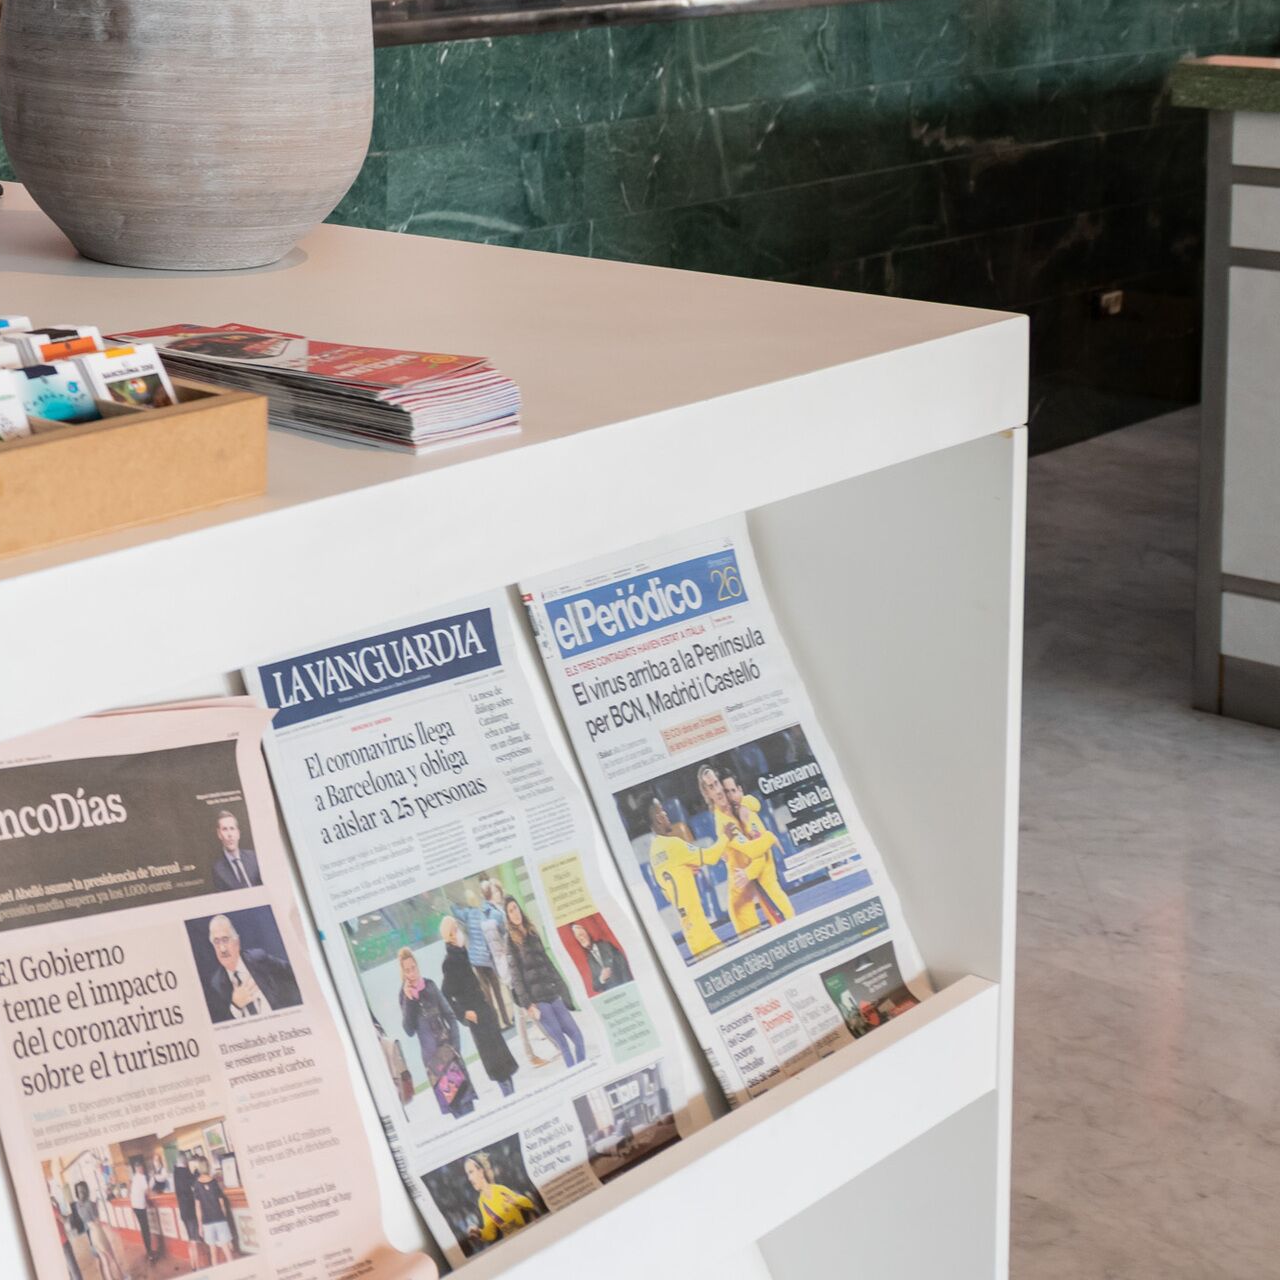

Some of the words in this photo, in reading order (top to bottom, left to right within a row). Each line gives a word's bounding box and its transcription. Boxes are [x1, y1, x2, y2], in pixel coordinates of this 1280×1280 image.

[709, 566, 744, 602] 26
[272, 666, 313, 709] LA
[306, 620, 487, 698] VANGUARDIA
[571, 682, 590, 706] El
[590, 674, 627, 700] virus
[626, 657, 668, 689] arriba
[668, 662, 680, 675] a
[679, 649, 695, 671] la
[693, 626, 765, 667] Península
[585, 713, 611, 743] per
[608, 699, 653, 728] BCN,
[646, 681, 700, 719] Madrid
[704, 657, 761, 696] Castelló
[304, 752, 325, 780] El
[326, 732, 423, 773] coronavirus
[415, 721, 456, 746] llega
[757, 761, 822, 795] Griezmann
[314, 794, 326, 812] a
[325, 770, 409, 809] Barcelona
[406, 764, 418, 788] y
[420, 748, 469, 779] obliga
[787, 791, 820, 814] salva
[818, 785, 832, 802] la
[321, 827, 333, 845] a
[333, 808, 380, 840] aislar
[379, 807, 393, 825] a
[390, 796, 416, 821] 25
[414, 776, 488, 820] personas
[789, 810, 844, 846] papereta
[83, 869, 137, 891] presidencia
[137, 867, 149, 879] de
[19, 943, 125, 983] Gobierno
[697, 979, 714, 999] La
[711, 970, 735, 993] taula
[733, 965, 747, 982] de
[771, 945, 791, 965] neix
[789, 932, 816, 954] entre
[853, 902, 884, 925] recels
[2, 991, 62, 1024] teme
[66, 982, 88, 1011] el
[88, 968, 178, 1007] impacto
[12, 1027, 48, 1060] del
[52, 1004, 185, 1051] coronavirus
[21, 1062, 86, 1096] sobre
[89, 1051, 111, 1080] el
[113, 1037, 200, 1075] turismo
